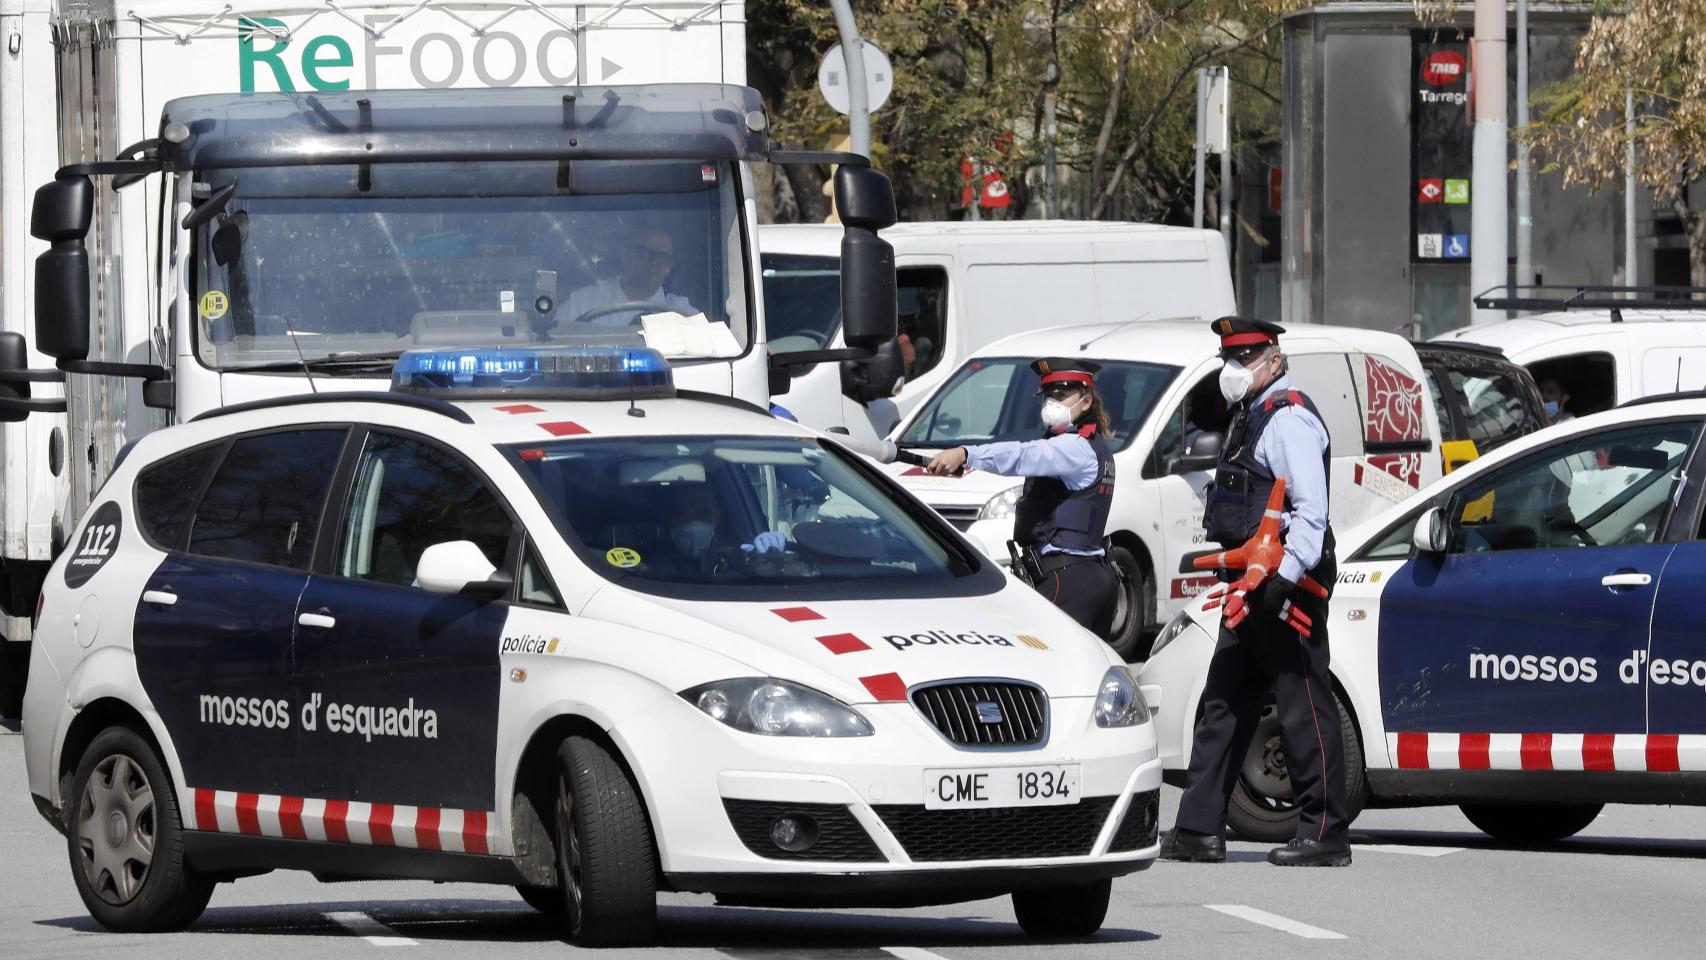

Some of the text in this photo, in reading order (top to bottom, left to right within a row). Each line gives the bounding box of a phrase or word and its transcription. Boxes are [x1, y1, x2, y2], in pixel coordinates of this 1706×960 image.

[237, 5, 588, 97] ReFood
[1430, 63, 1460, 75] TMB
[80, 524, 116, 555] 112
[1336, 571, 1366, 584] licia
[501, 634, 547, 655] policia
[882, 630, 1015, 651] policia
[1469, 653, 1598, 683] mossos
[200, 694, 290, 730] mossos
[938, 770, 1070, 802] CME 1834
